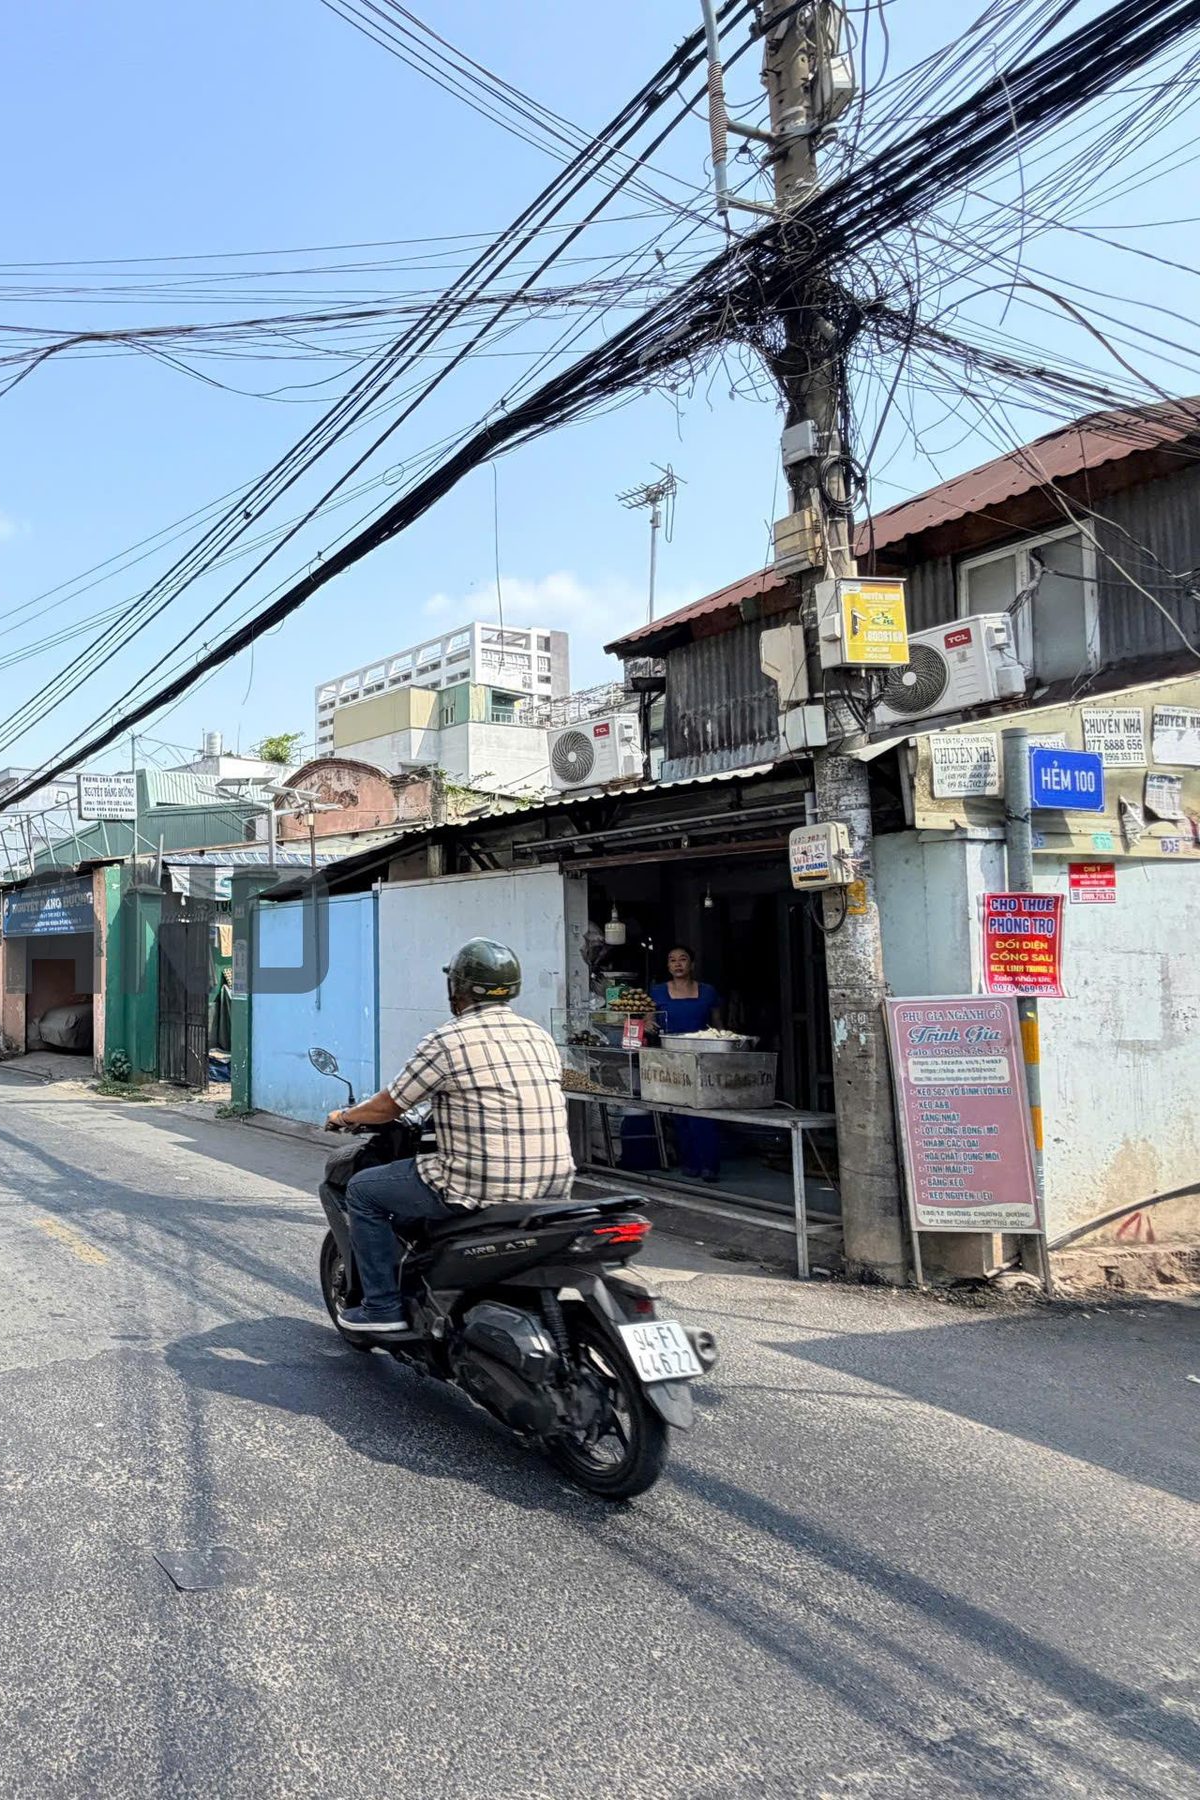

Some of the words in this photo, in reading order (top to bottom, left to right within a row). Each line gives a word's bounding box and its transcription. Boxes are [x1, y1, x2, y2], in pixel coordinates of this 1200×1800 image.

[948, 633, 968, 643] TCL
[1041, 760, 1072, 791] HẺM
[1074, 770, 1095, 793] 100
[991, 897, 1017, 912] CHO
[1022, 896, 1054, 912] THUÊ
[989, 913, 1030, 934] PHÒNG
[1032, 917, 1054, 938] TRỌ
[1031, 954, 1054, 962] SAU
[965, 1025, 1002, 1044] Gia
[633, 1326, 680, 1351] 94-F1
[638, 1349, 699, 1378] 446.22
